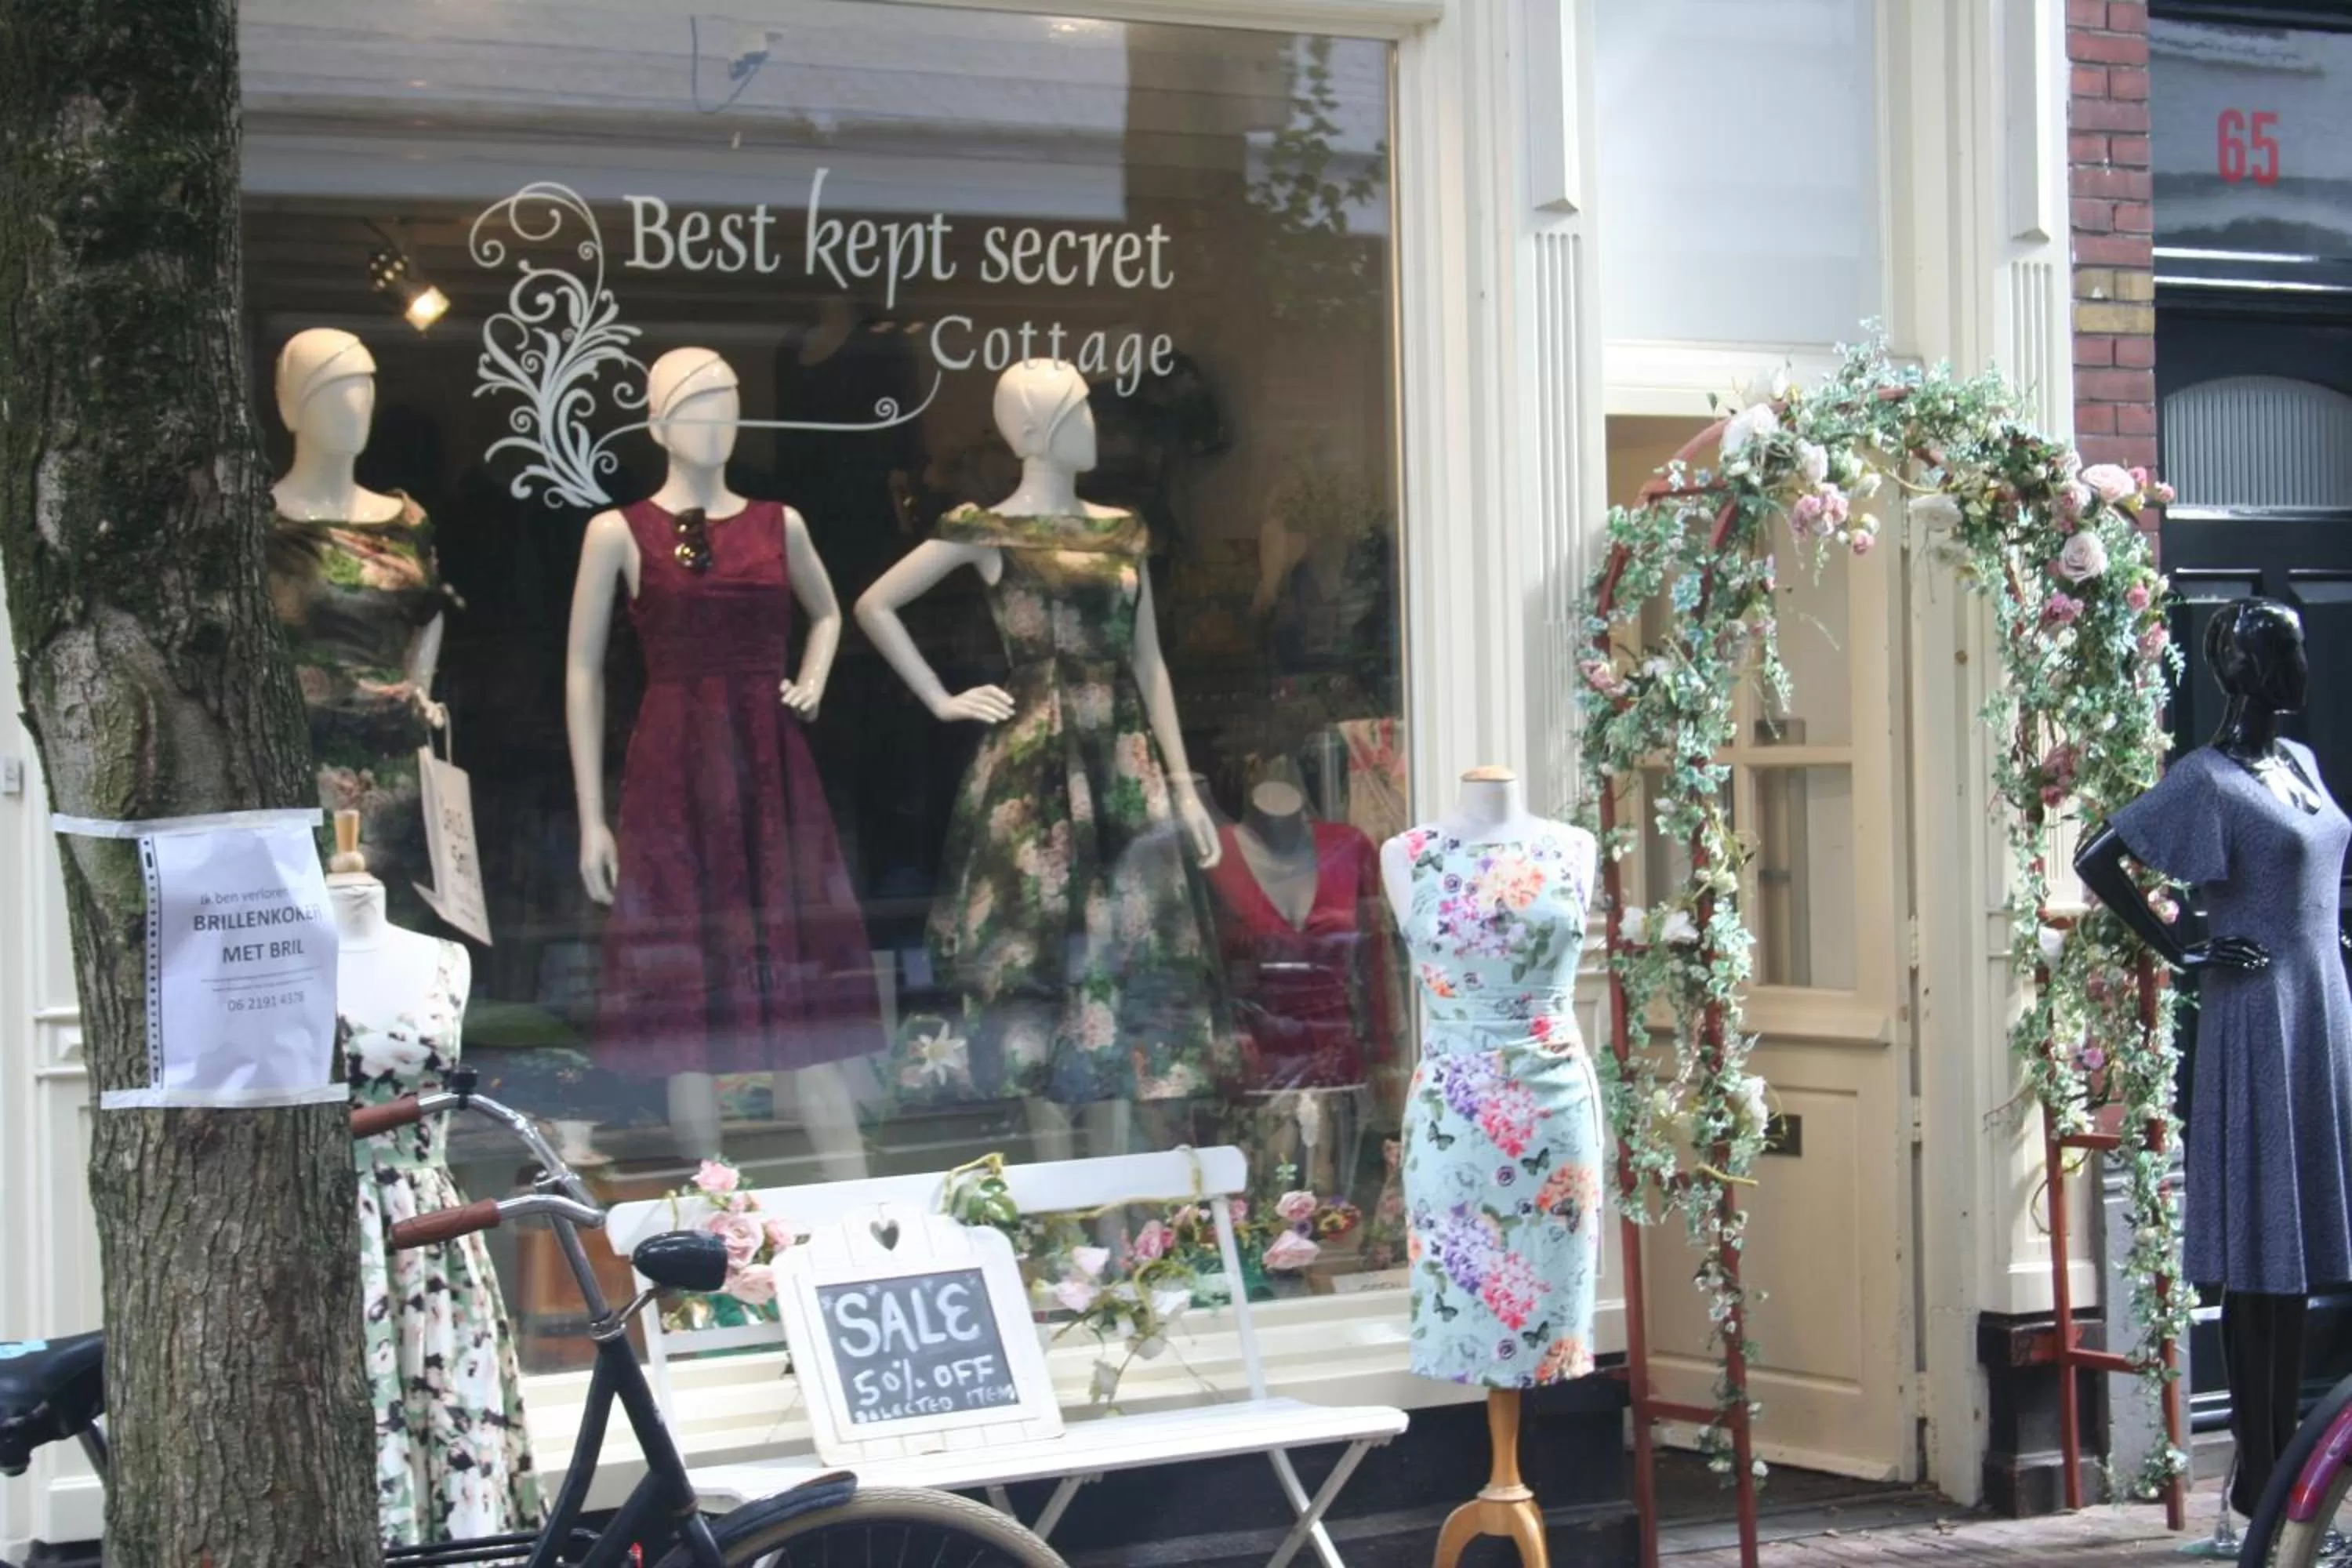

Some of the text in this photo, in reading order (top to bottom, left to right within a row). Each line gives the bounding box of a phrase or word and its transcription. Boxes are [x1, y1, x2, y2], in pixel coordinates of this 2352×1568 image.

[2217, 107, 2280, 187] 65
[623, 167, 1175, 310] Best kept secret
[930, 314, 1175, 398] Cottage
[223, 938, 304, 964] MET BRIL
[227, 999, 245, 1012] 06
[834, 1283, 980, 1358] SALE
[852, 1354, 995, 1406] 50% OFF
